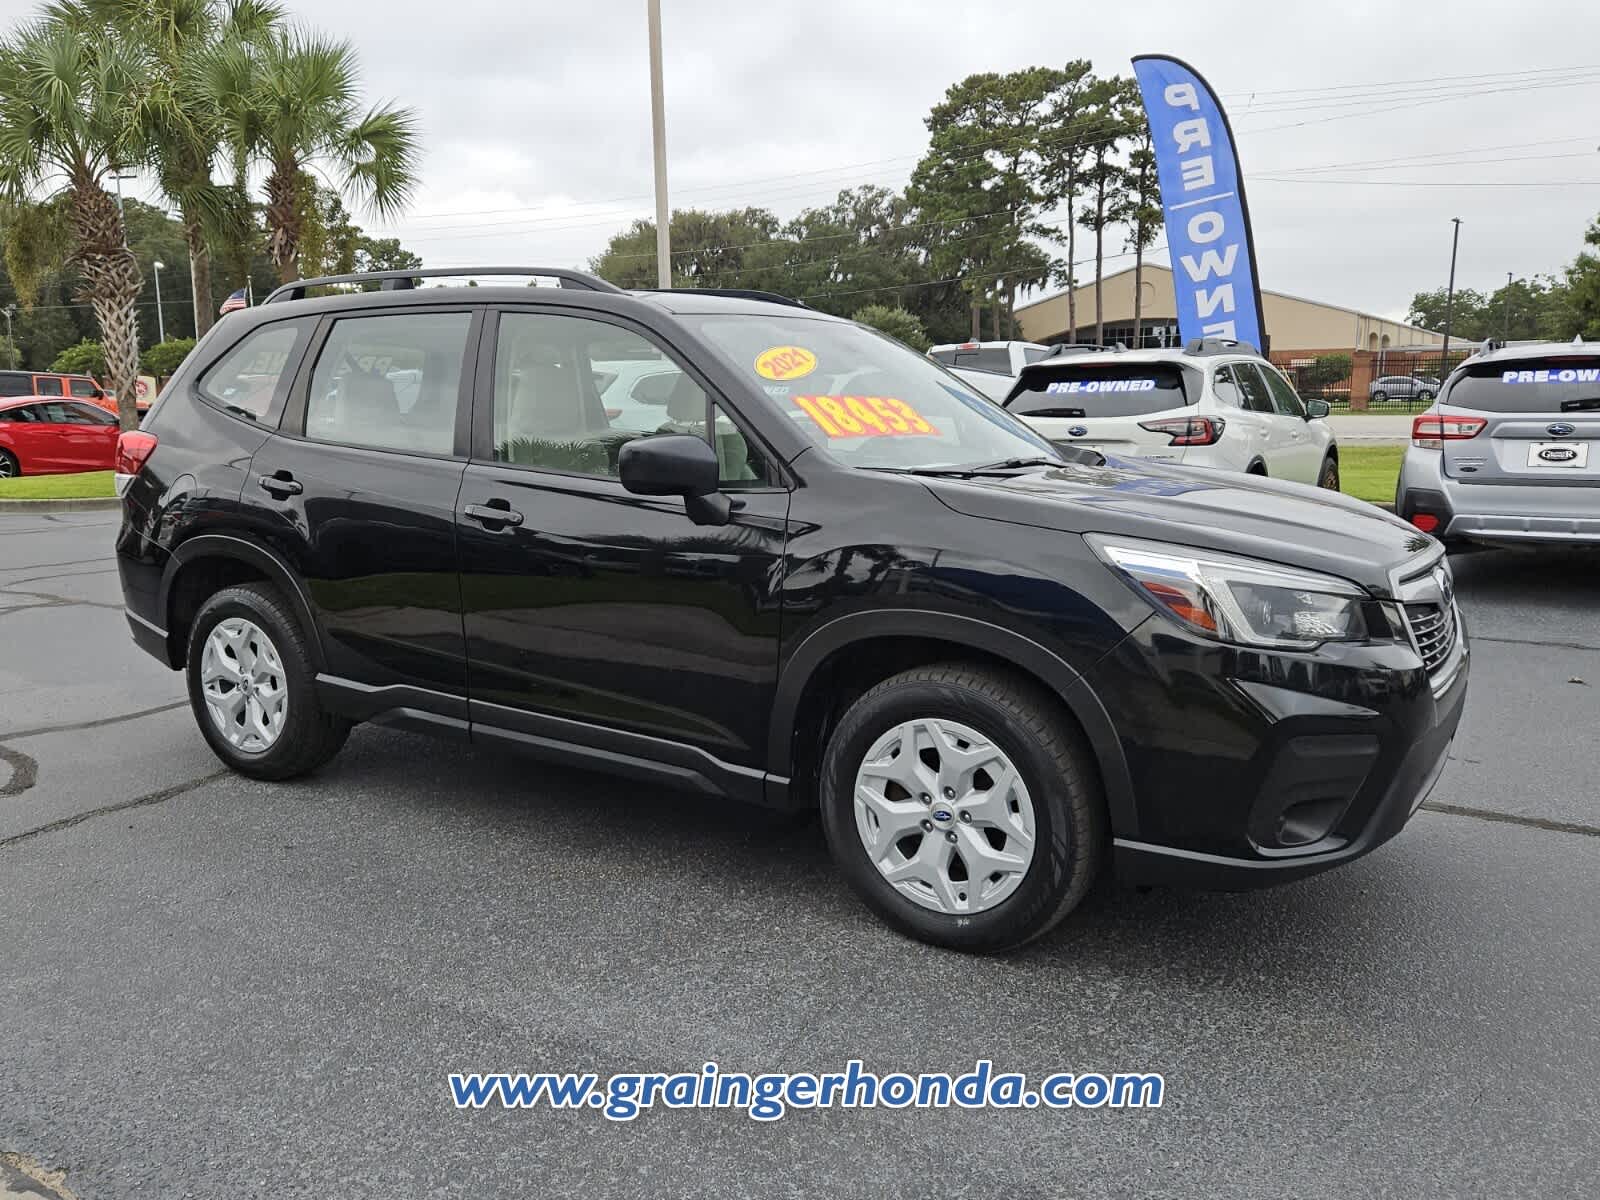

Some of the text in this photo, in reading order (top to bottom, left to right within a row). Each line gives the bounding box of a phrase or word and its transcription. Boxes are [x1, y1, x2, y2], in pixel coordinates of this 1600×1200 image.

[761, 348, 811, 377] 2021
[1046, 379, 1156, 394] PRE-OWNED
[793, 395, 936, 437] 18453
